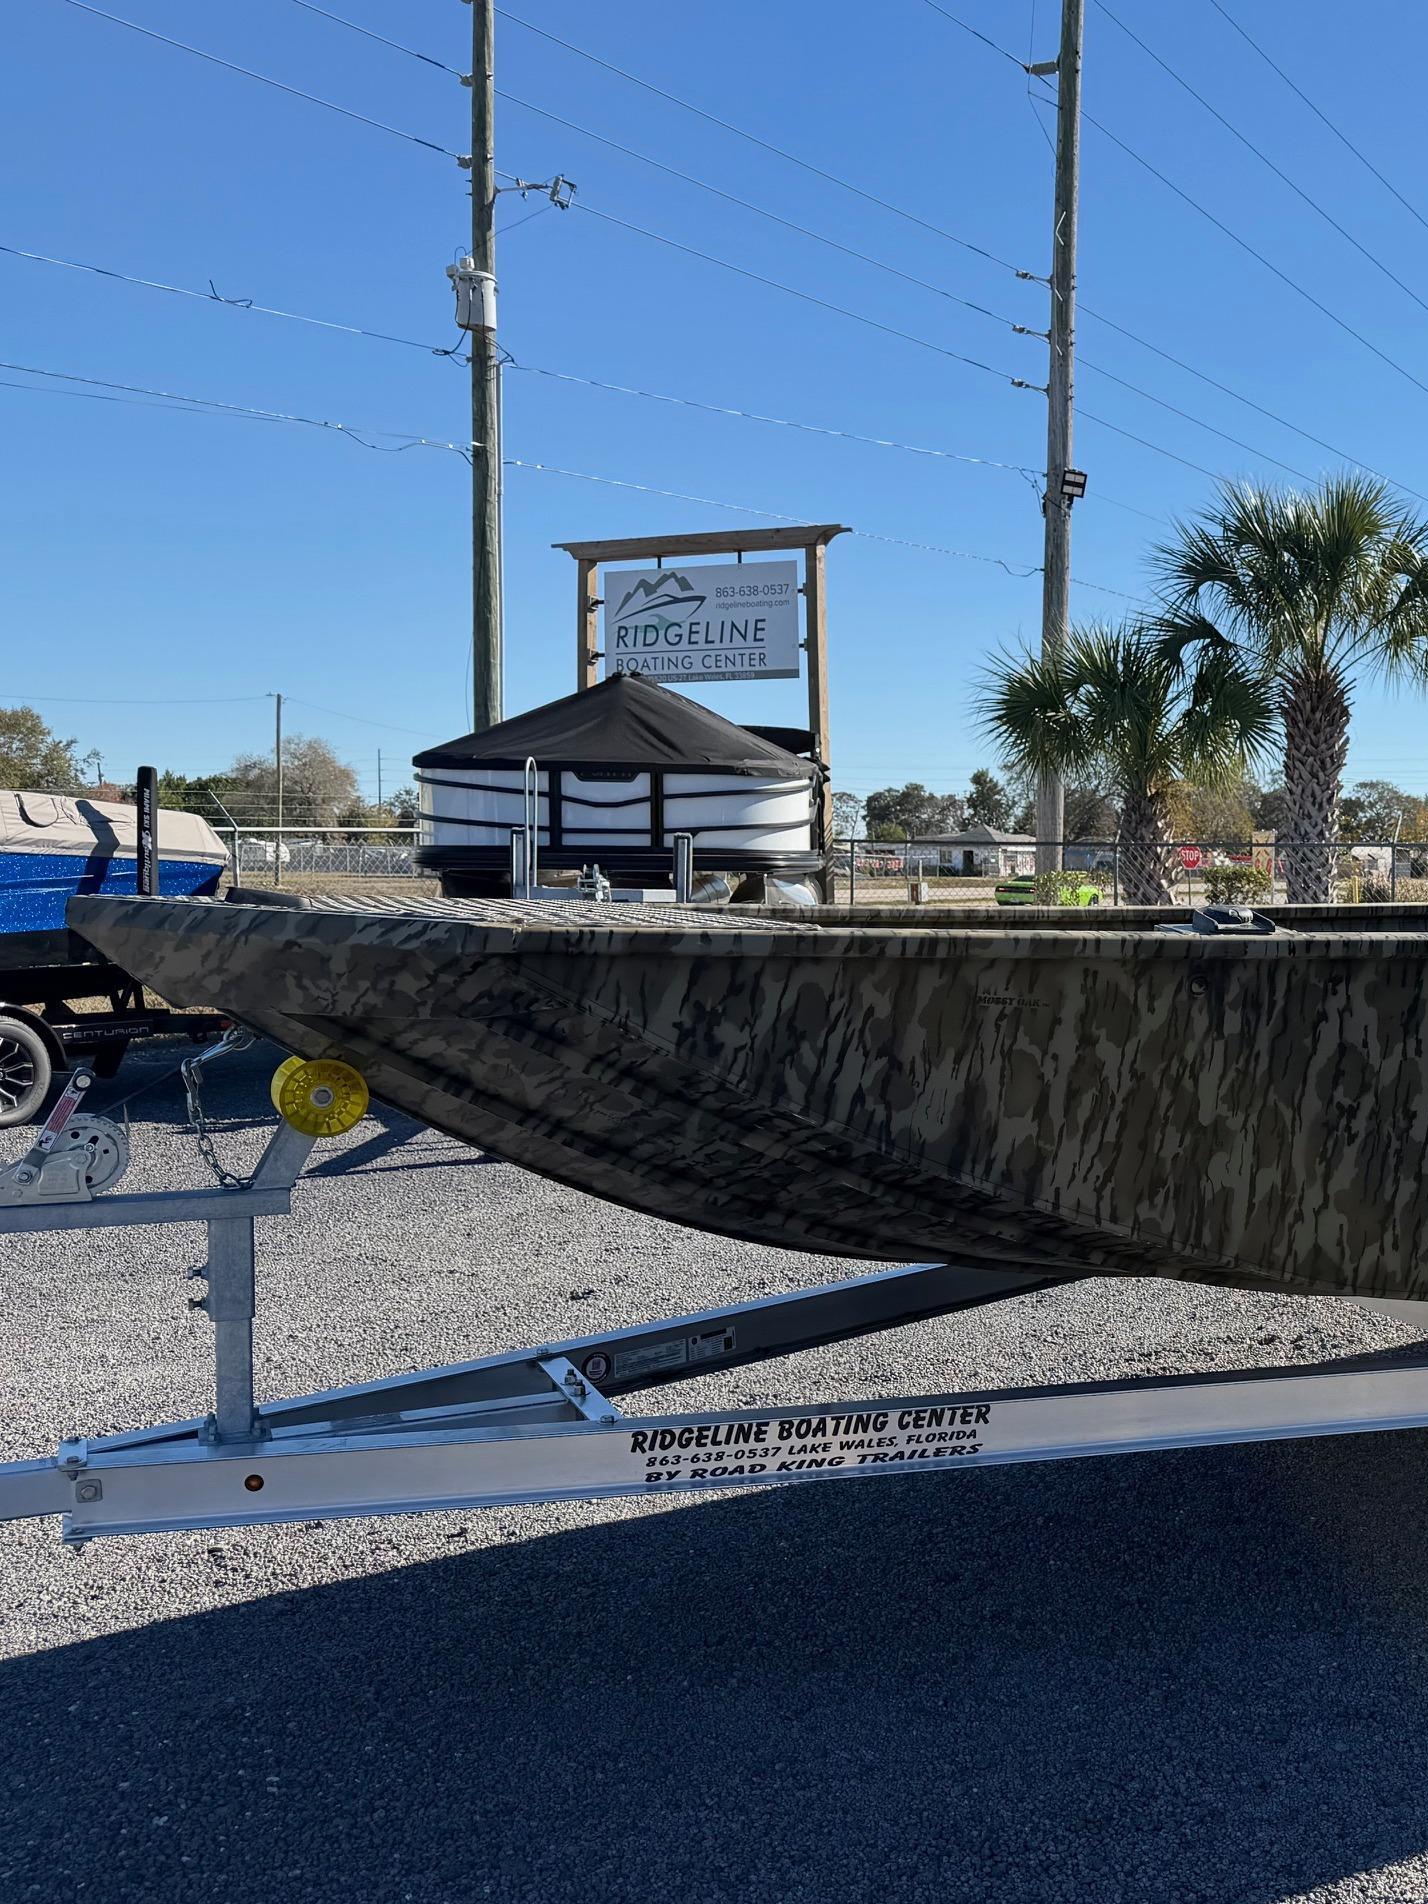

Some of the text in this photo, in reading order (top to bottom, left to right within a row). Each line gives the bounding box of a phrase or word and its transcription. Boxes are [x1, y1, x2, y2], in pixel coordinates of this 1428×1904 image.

[715, 584, 790, 598] 863-638-0537
[715, 599, 790, 611] ridgelineboating.com
[616, 618, 766, 648] RIDGELINE
[616, 652, 767, 672] BOATING CENTER
[1181, 850, 1199, 861] STOP
[1018, 997, 1040, 1007] OAK
[62, 1026, 149, 1039] CENTURION
[630, 1403, 991, 1454] RIDGELINE BOATING CENTER
[645, 1429, 977, 1468] 863-638-0537 LAKE WALES, FLORIDA
[645, 1443, 983, 1483] BY ROAD KING TRAILERS
